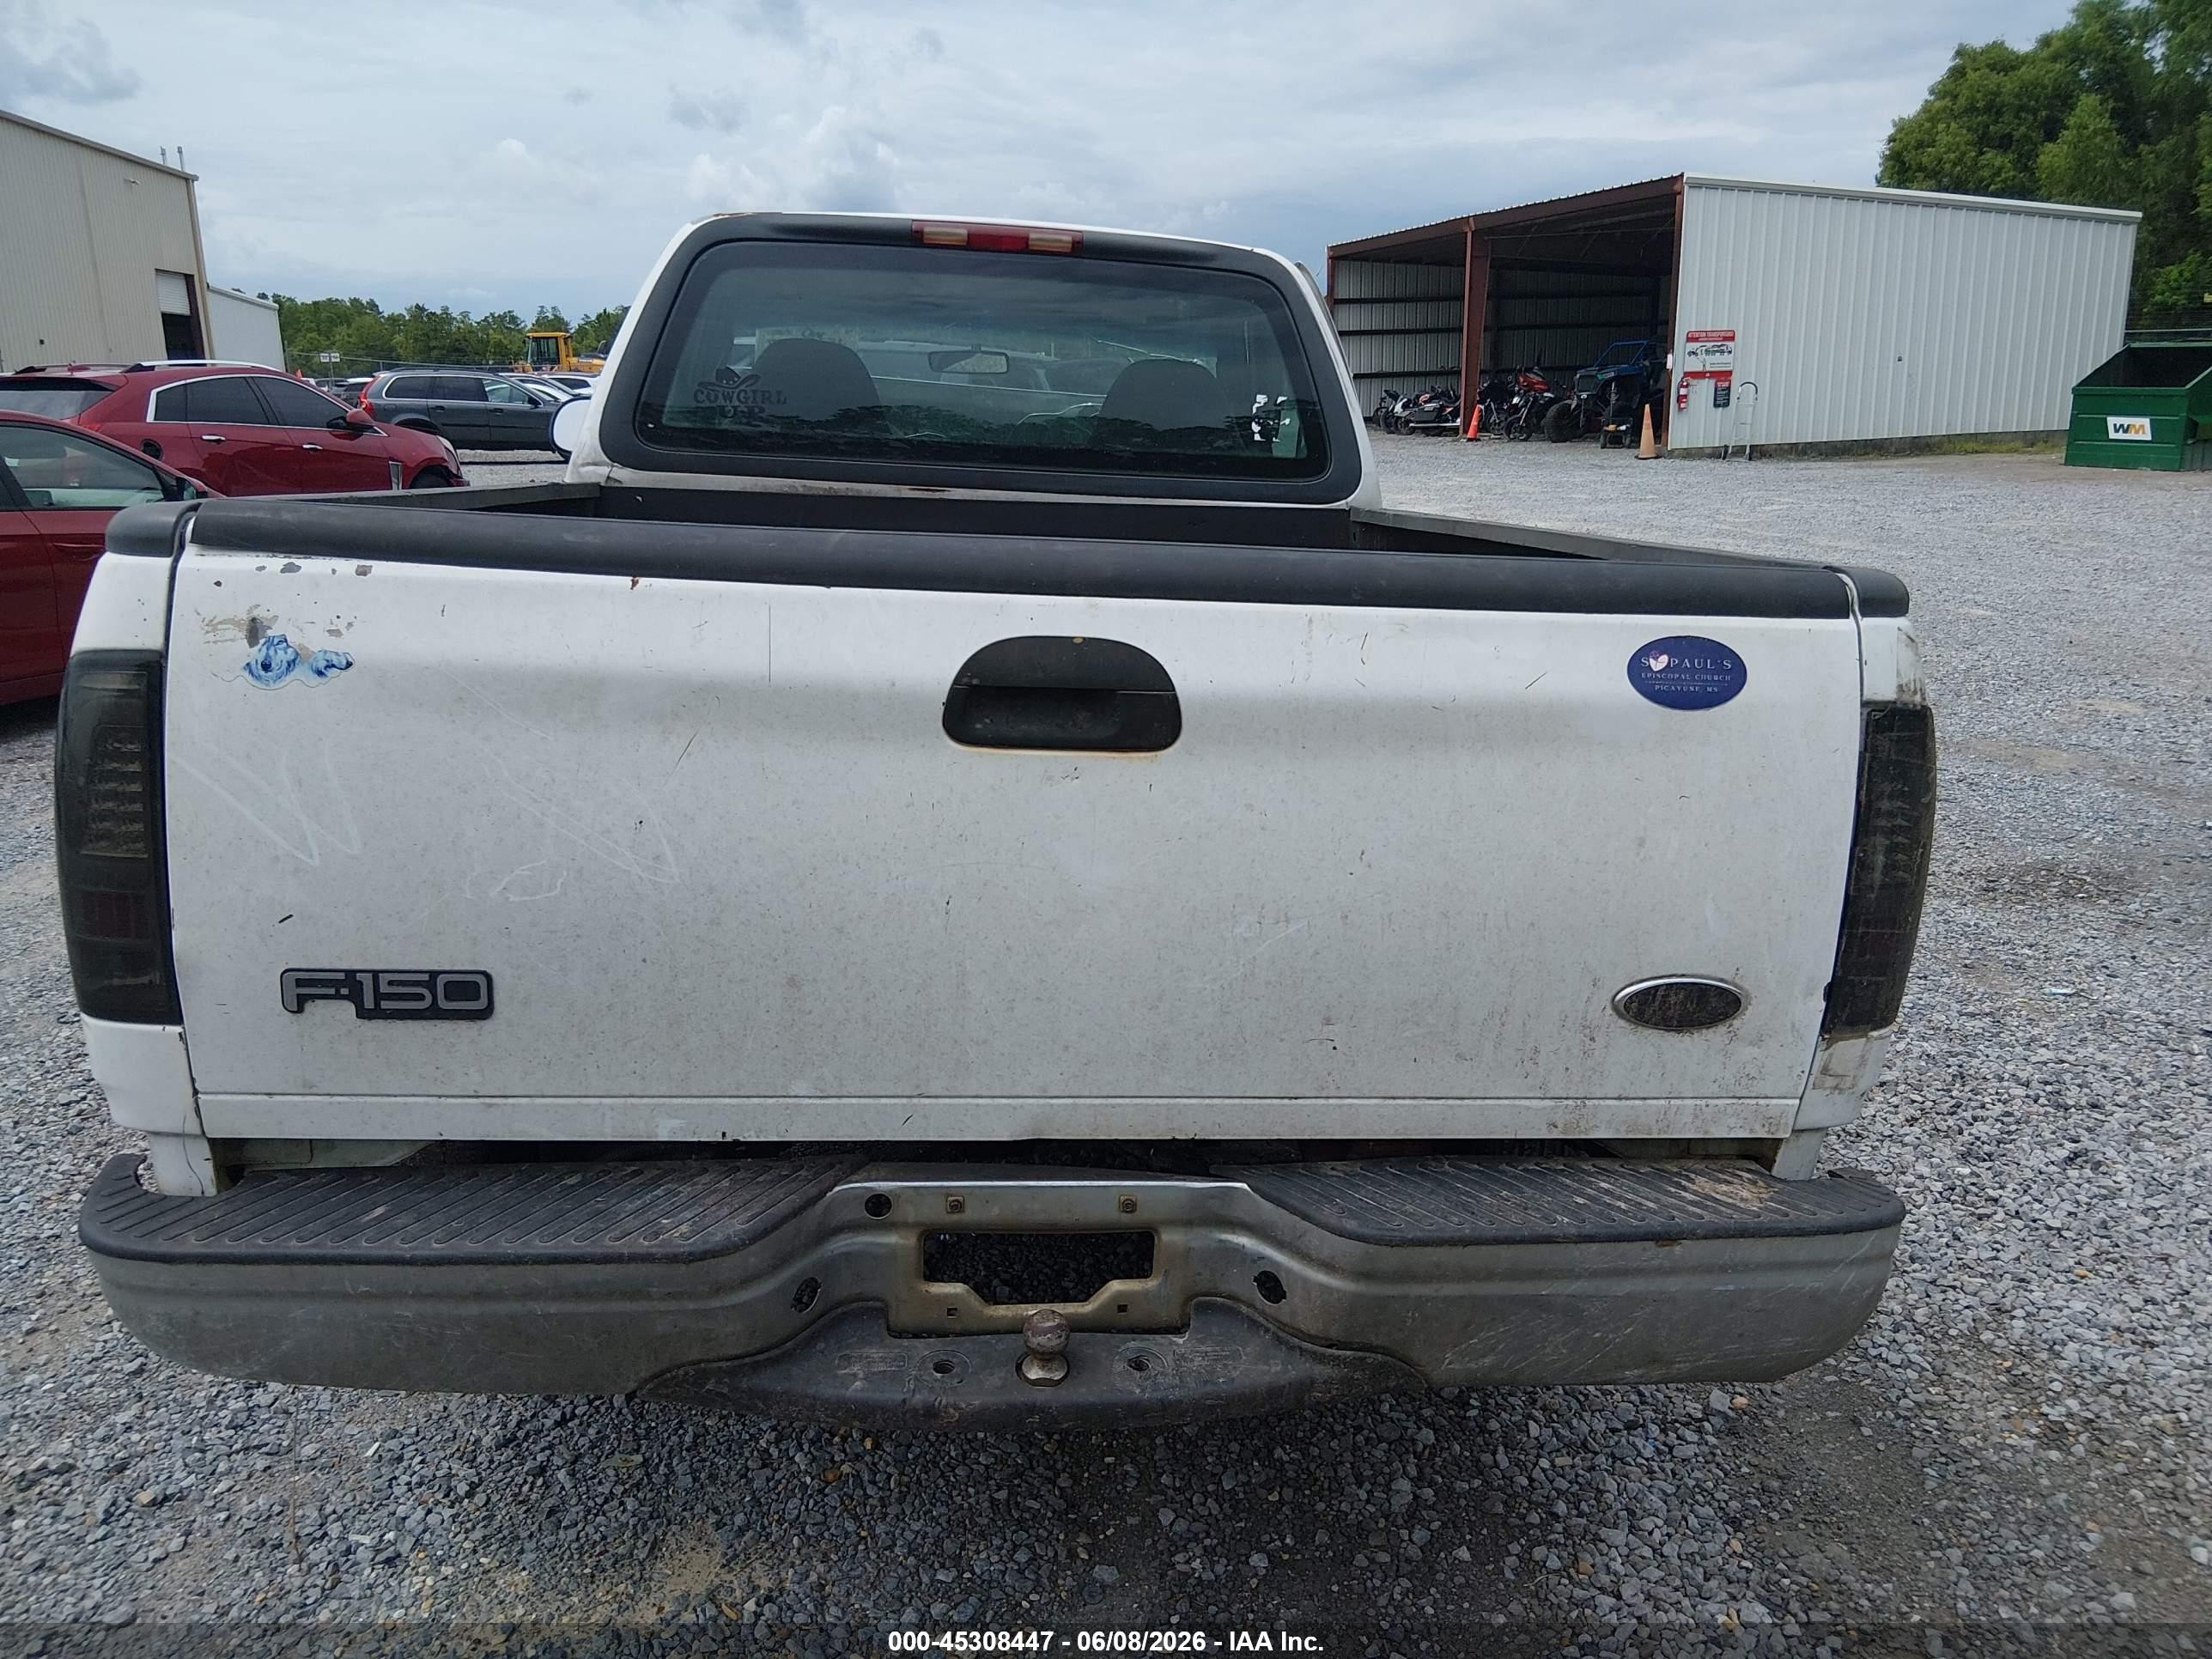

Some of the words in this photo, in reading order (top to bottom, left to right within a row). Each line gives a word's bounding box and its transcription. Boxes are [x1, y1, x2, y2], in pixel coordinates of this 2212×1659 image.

[693, 389, 787, 405] COWGIRL
[714, 404, 766, 419] UP
[2113, 422, 2146, 434] WM
[1641, 672, 1692, 681] EPISCOPAL
[282, 972, 489, 1012] F-150
